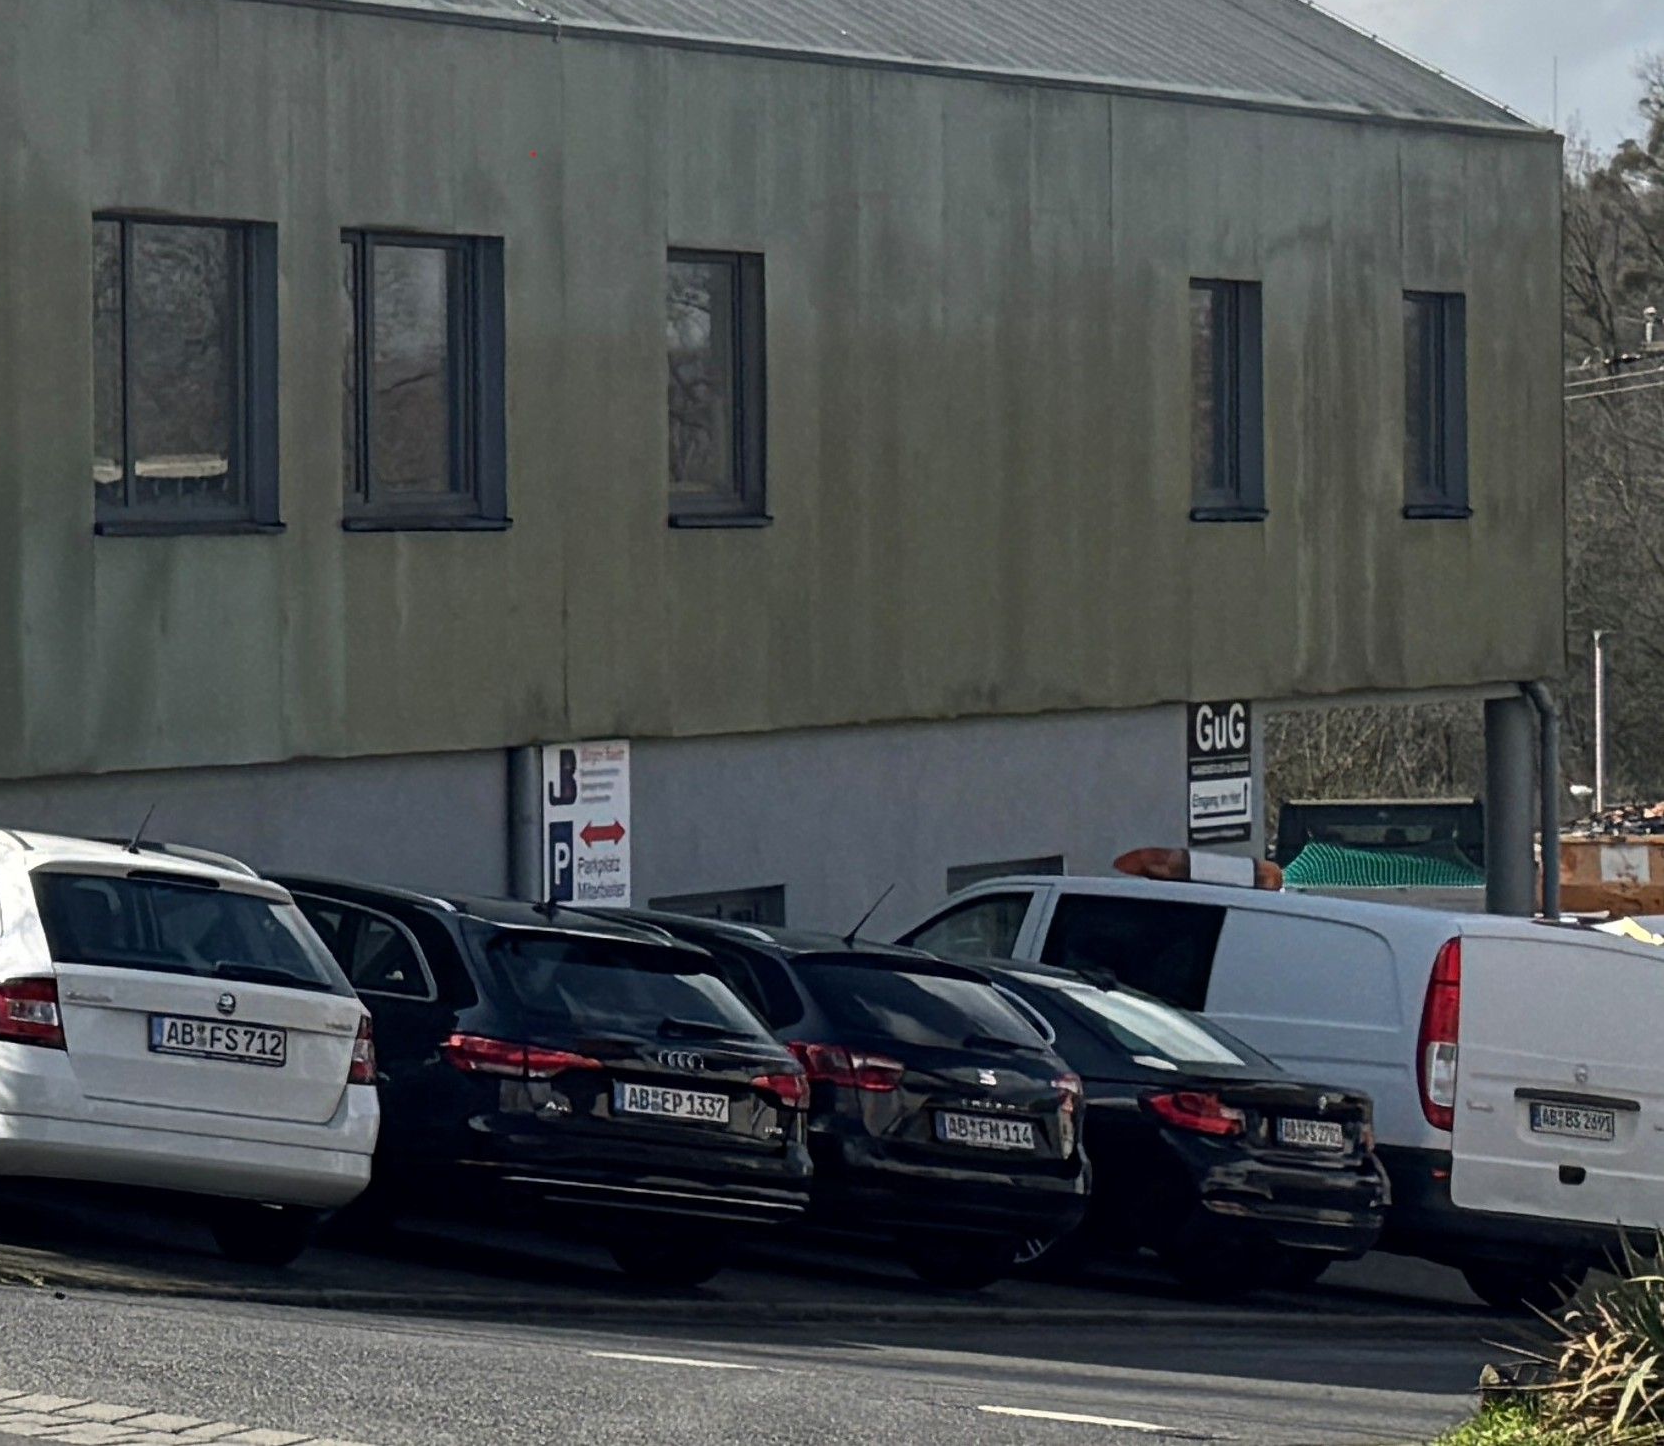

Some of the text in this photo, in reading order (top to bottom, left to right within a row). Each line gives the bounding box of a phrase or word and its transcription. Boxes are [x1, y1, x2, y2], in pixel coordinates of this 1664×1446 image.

[1196, 702, 1246, 752] GuG
[554, 842, 571, 885] P
[166, 1021, 195, 1046] AB
